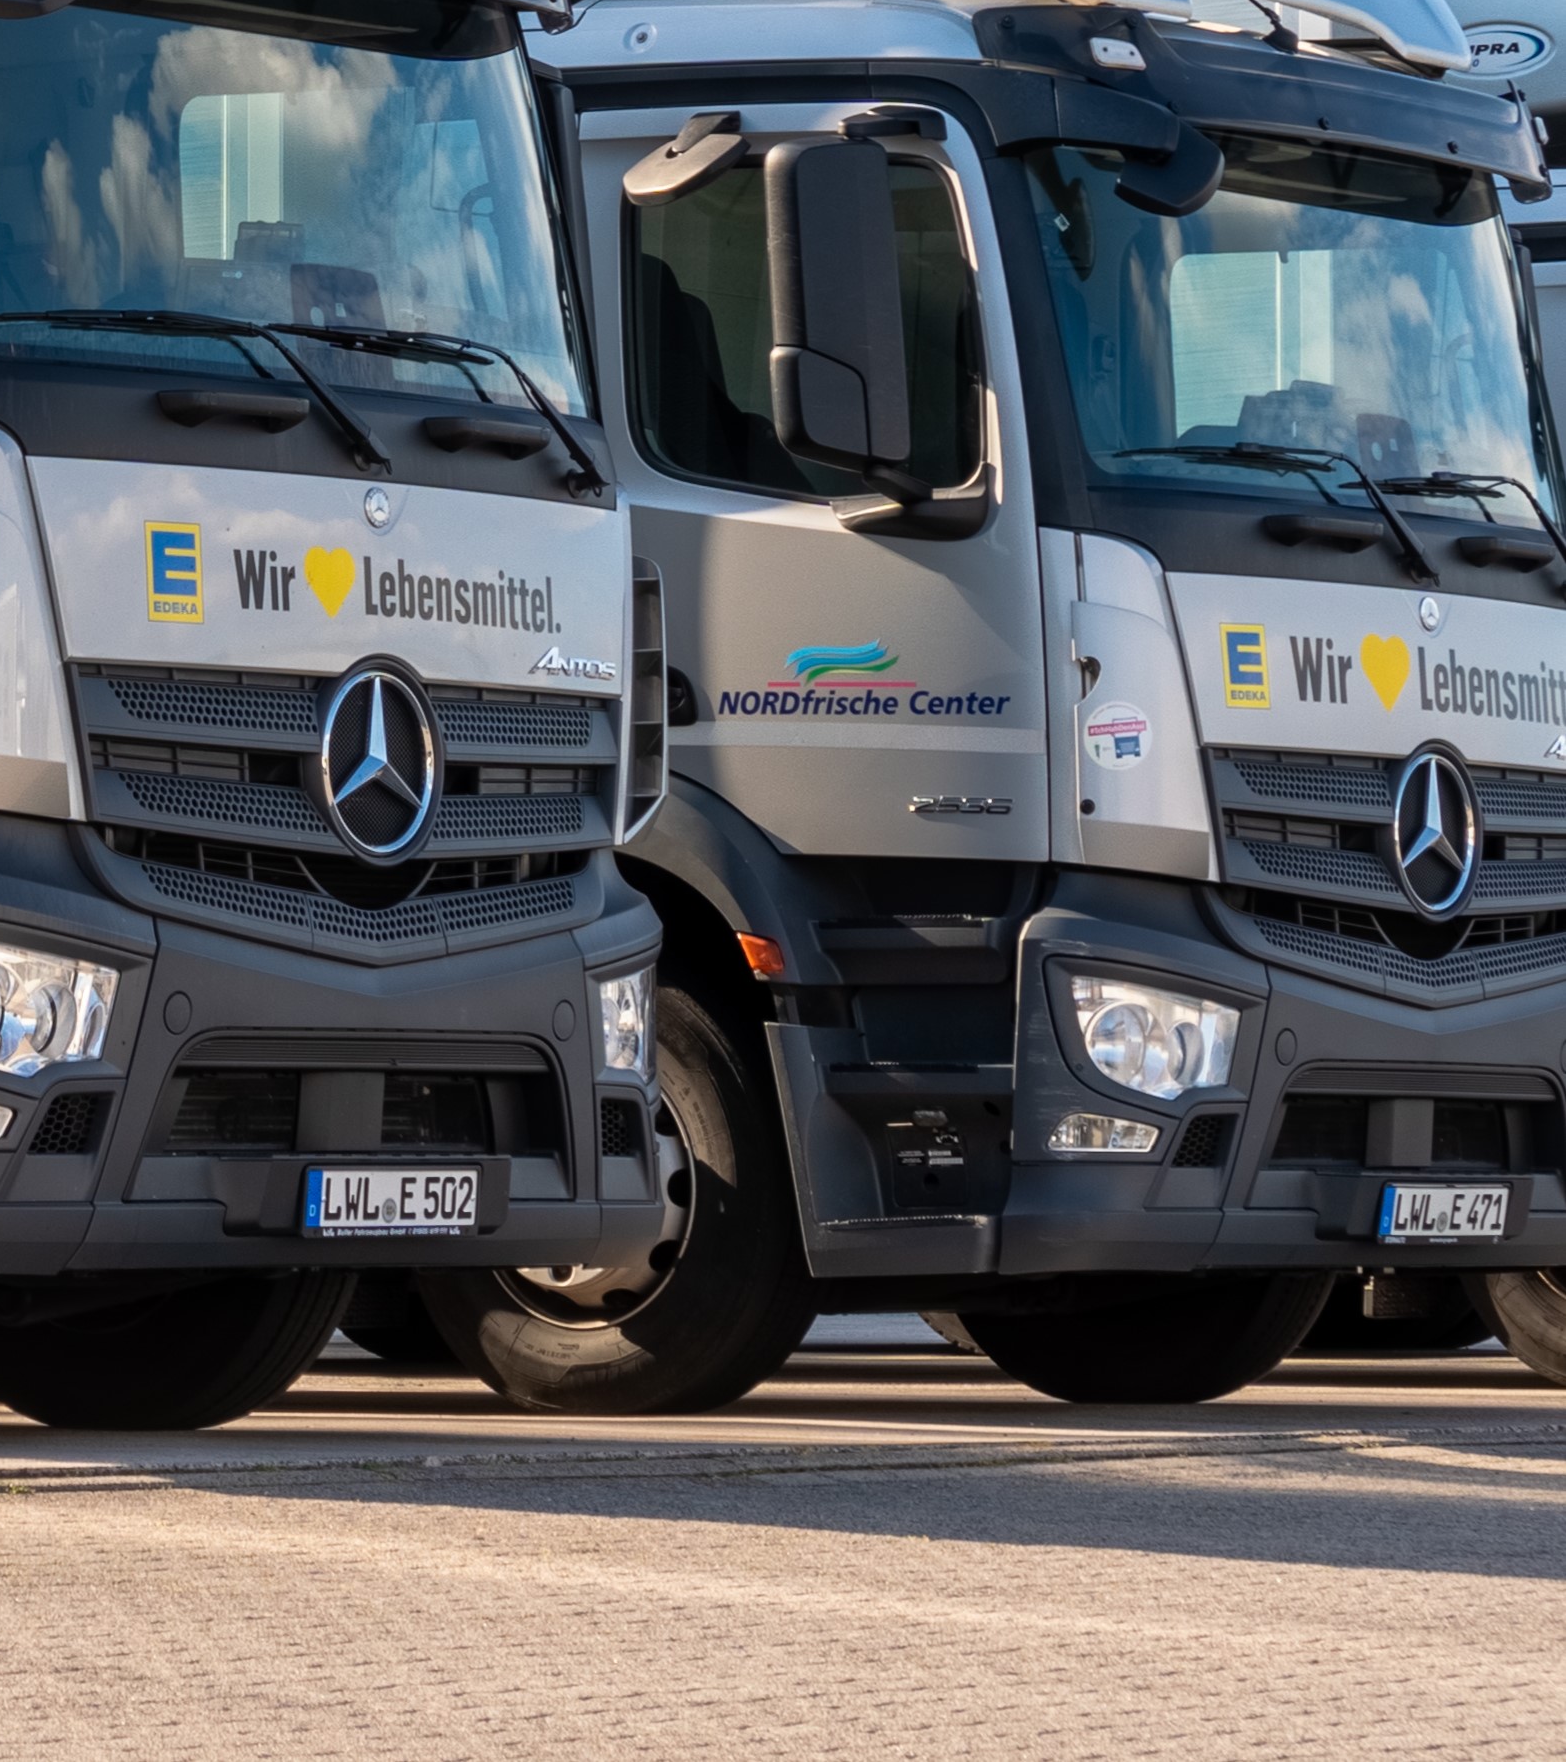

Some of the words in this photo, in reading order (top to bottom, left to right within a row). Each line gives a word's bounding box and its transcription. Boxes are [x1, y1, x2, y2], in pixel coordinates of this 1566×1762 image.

[153, 601, 198, 616] EDEKA
[234, 549, 296, 612] Wir
[364, 555, 562, 634] Lebensmittel.
[1290, 636, 1353, 704] Wir
[719, 690, 899, 715] NORDfrische
[909, 691, 1010, 715] Center
[1231, 691, 1267, 702] EDEKA
[324, 1177, 379, 1220] LWL
[1394, 1194, 1436, 1230] LWL
